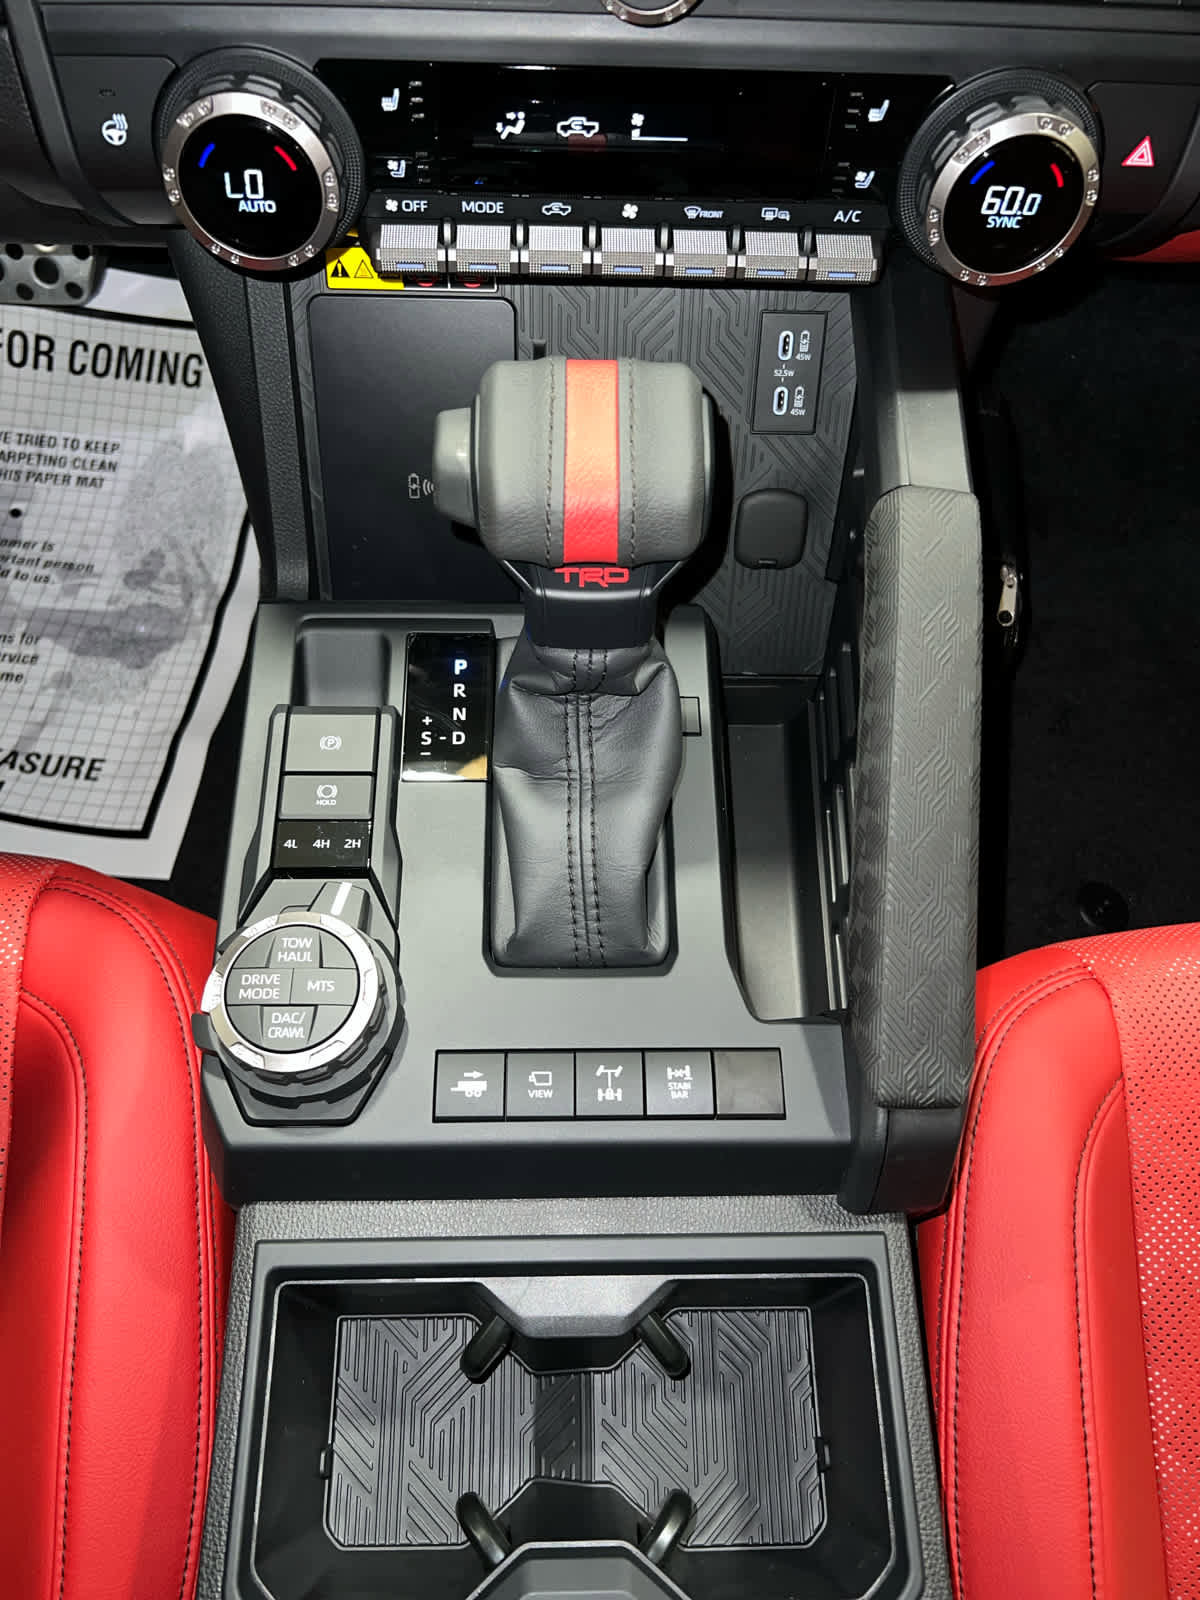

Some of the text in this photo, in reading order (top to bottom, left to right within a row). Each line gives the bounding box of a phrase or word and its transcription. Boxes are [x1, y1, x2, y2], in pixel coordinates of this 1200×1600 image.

[223, 168, 264, 200] LO
[238, 199, 277, 213] AUTO
[401, 200, 428, 212] OFF
[980, 184, 1043, 216] 60.0
[461, 201, 505, 214] MODE
[699, 210, 724, 219] FRONT
[833, 209, 862, 223] A/C
[985, 215, 1023, 229] SYNC
[0, 327, 204, 389] OR COMING
[17, 432, 57, 449] TRIED
[63, 437, 81, 451] TO
[84, 439, 120, 455] KEEP
[72, 456, 118, 473] CLEAN
[25, 471, 72, 488] PAPER
[75, 476, 105, 489] MAT
[42, 560, 95, 576] person
[14, 570, 30, 582] to
[553, 566, 630, 589] TRD
[19, 632, 40, 646] for
[453, 658, 468, 676] P
[453, 683, 467, 698] R
[452, 707, 467, 721] N
[420, 730, 432, 746] S
[451, 730, 466, 745] D
[0, 748, 106, 782] ASURE
[283, 838, 361, 849] 4L 4H 2H
[281, 937, 313, 949] TOW
[277, 951, 313, 962] HAUL
[241, 973, 281, 986] DRIVE
[306, 980, 336, 992] MTS
[238, 988, 280, 1000] MODE
[271, 1011, 305, 1024] DAC/
[267, 1026, 305, 1039] CRAWL
[527, 1089, 553, 1099] VIEW
[670, 1090, 689, 1100] BAR
